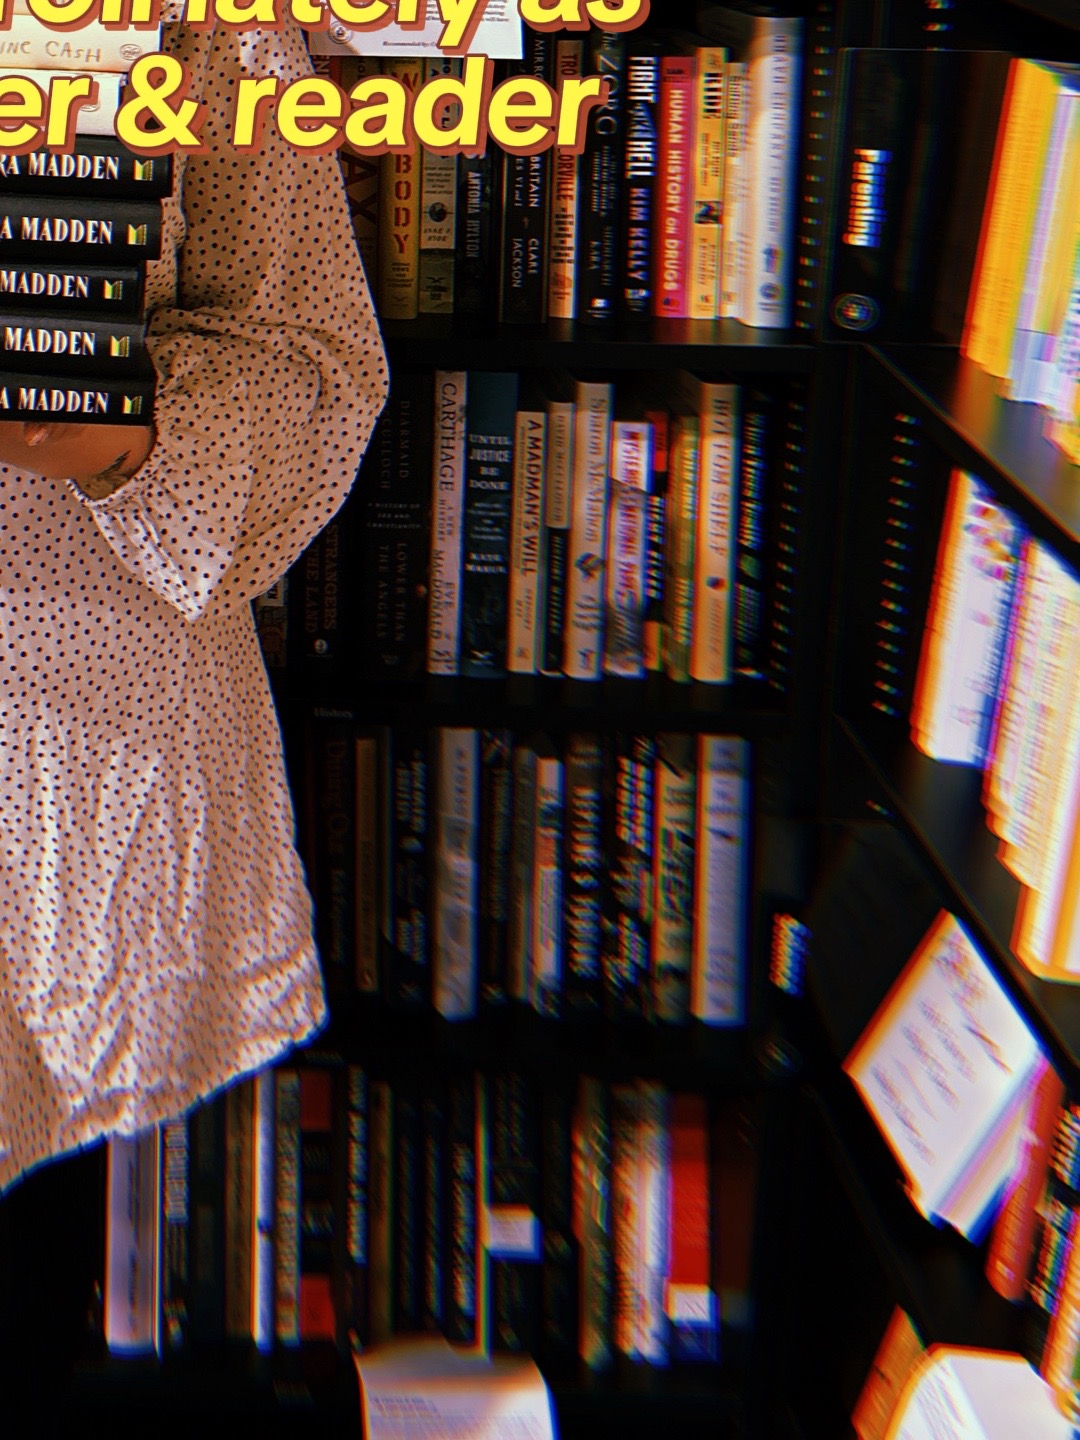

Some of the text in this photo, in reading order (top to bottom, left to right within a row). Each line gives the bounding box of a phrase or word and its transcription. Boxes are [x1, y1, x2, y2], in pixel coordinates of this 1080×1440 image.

[45, 40, 102, 63] CASH
[28, 153, 120, 181] MADDEN
[393, 154, 412, 254] BODY
[663, 90, 685, 291] HUMAN HISTORY ON DRUGS
[842, 148, 893, 248] Parenting
[22, 217, 114, 245] MADDEN
[466, 171, 482, 258] ANTONIA HYLTON
[0, 269, 90, 299] MADDEN
[4, 326, 96, 357] MADDEN
[19, 388, 109, 414] MADDEN
[439, 382, 457, 492] CARTHAGE
[521, 420, 542, 577] A MADMAN'S WILL
[584, 398, 606, 542] Sharon McMahon
